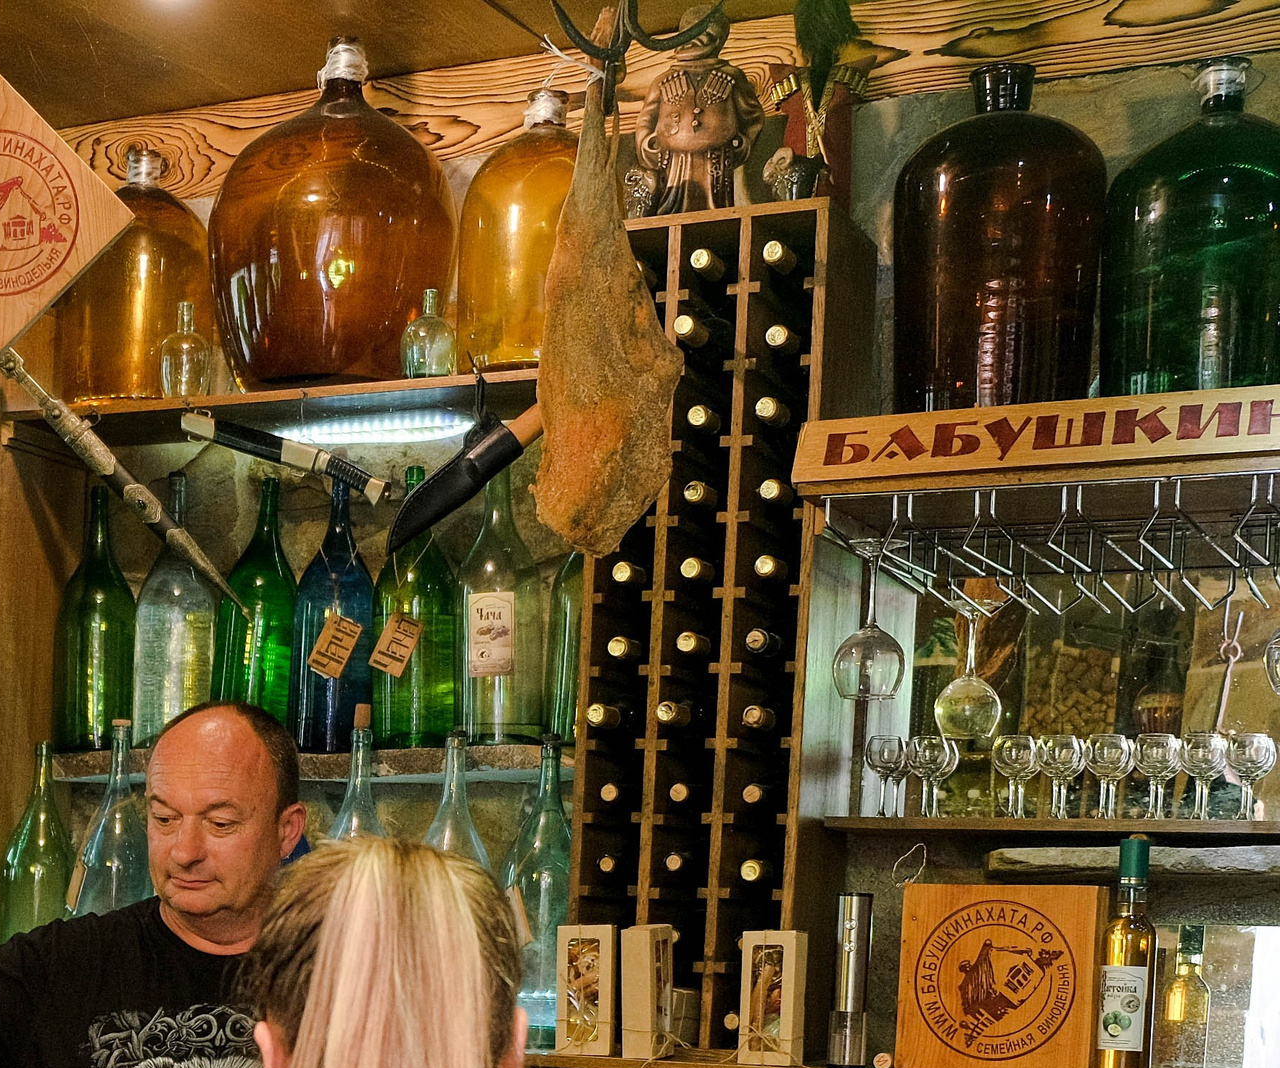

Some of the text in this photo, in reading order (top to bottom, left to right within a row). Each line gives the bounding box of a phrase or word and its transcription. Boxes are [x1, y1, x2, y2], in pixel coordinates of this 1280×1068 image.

[921, 907, 1054, 1041] WWW.БАБУШКИНАХАТА.РФ
[976, 1032, 1036, 1055] СЕМЕЙНАЯ
[1037, 963, 1070, 1035] ВИНОДЕЛЬНЯ
